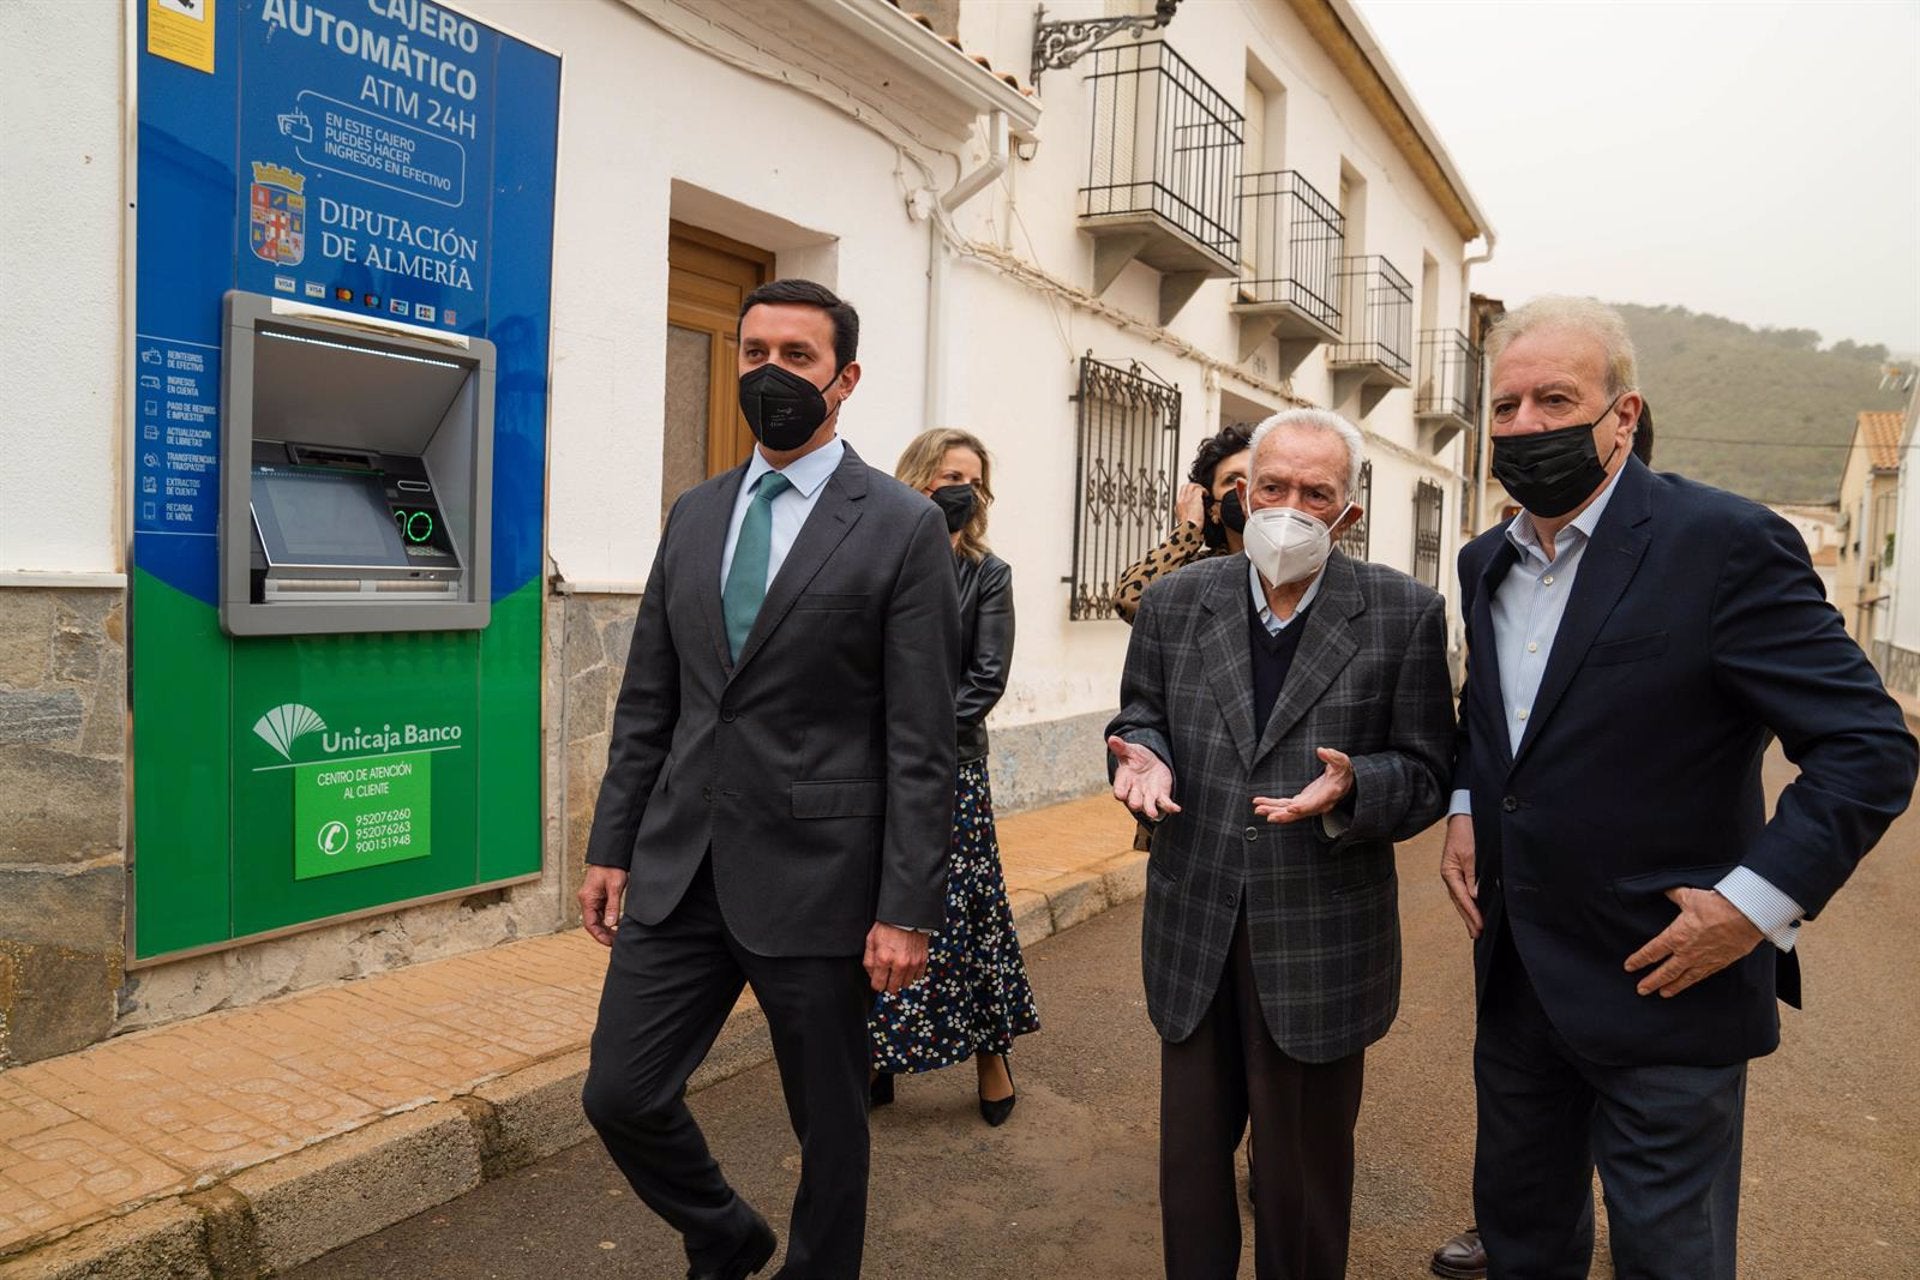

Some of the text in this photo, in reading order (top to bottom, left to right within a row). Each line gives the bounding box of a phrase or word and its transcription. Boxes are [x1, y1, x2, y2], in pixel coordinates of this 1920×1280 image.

[368, 0, 478, 53] CAJERO
[262, 0, 477, 100] AUTOMÁTICO
[360, 75, 476, 139] ATM 24H
[325, 112, 416, 152] EN ESTE CAJERO
[325, 127, 411, 164] PUEDES HACER
[325, 142, 451, 191] INGRESOS EN EFECTIVO
[319, 197, 478, 262] DIPUTACIÓN
[321, 231, 474, 291] DE ALMERÍA
[277, 278, 293, 289] VISA
[167, 359, 204, 372] DE EFECTIVO
[167, 385, 199, 396] EN CUENTA
[183, 403, 191, 412] DE
[167, 436, 203, 446] DE LIBRETAS
[172, 462, 206, 472] TRASPASOS
[166, 477, 201, 488] EXTRACTOS
[166, 486, 198, 496] DE CUENTA
[166, 503, 193, 512] RECARGA
[166, 511, 174, 520] DE
[322, 724, 462, 752] Unicaja Banco
[317, 761, 412, 786] CENTRO DE ATENCIÓN
[344, 782, 389, 799] AL CLIENTE
[355, 808, 411, 826] 952076260
[355, 821, 411, 840] 952076263
[355, 834, 411, 853] 900151948
